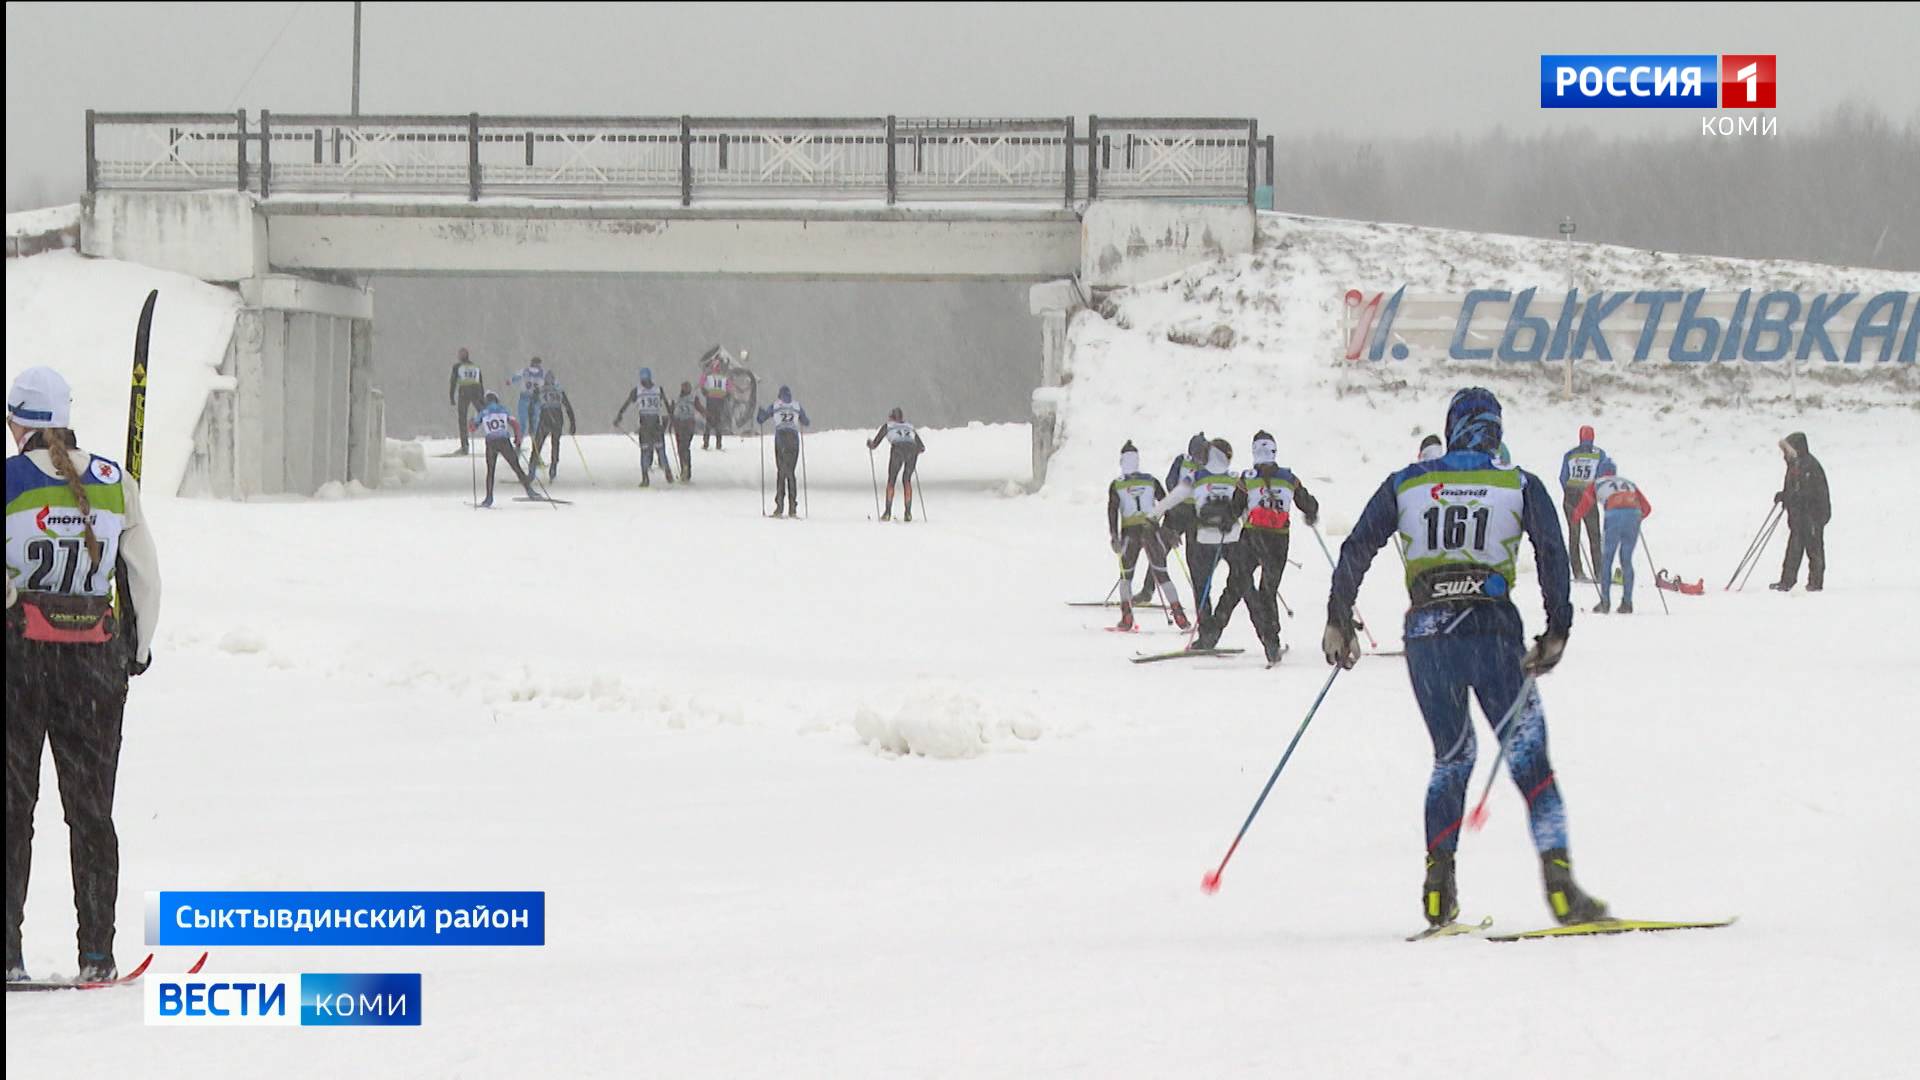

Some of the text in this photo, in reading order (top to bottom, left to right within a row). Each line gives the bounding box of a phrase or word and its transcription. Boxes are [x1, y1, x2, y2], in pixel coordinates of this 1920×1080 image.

[1571, 465, 1592, 479] 155
[1440, 488, 1489, 498] mondi
[1424, 505, 1490, 551] 161
[27, 539, 105, 594] 277
